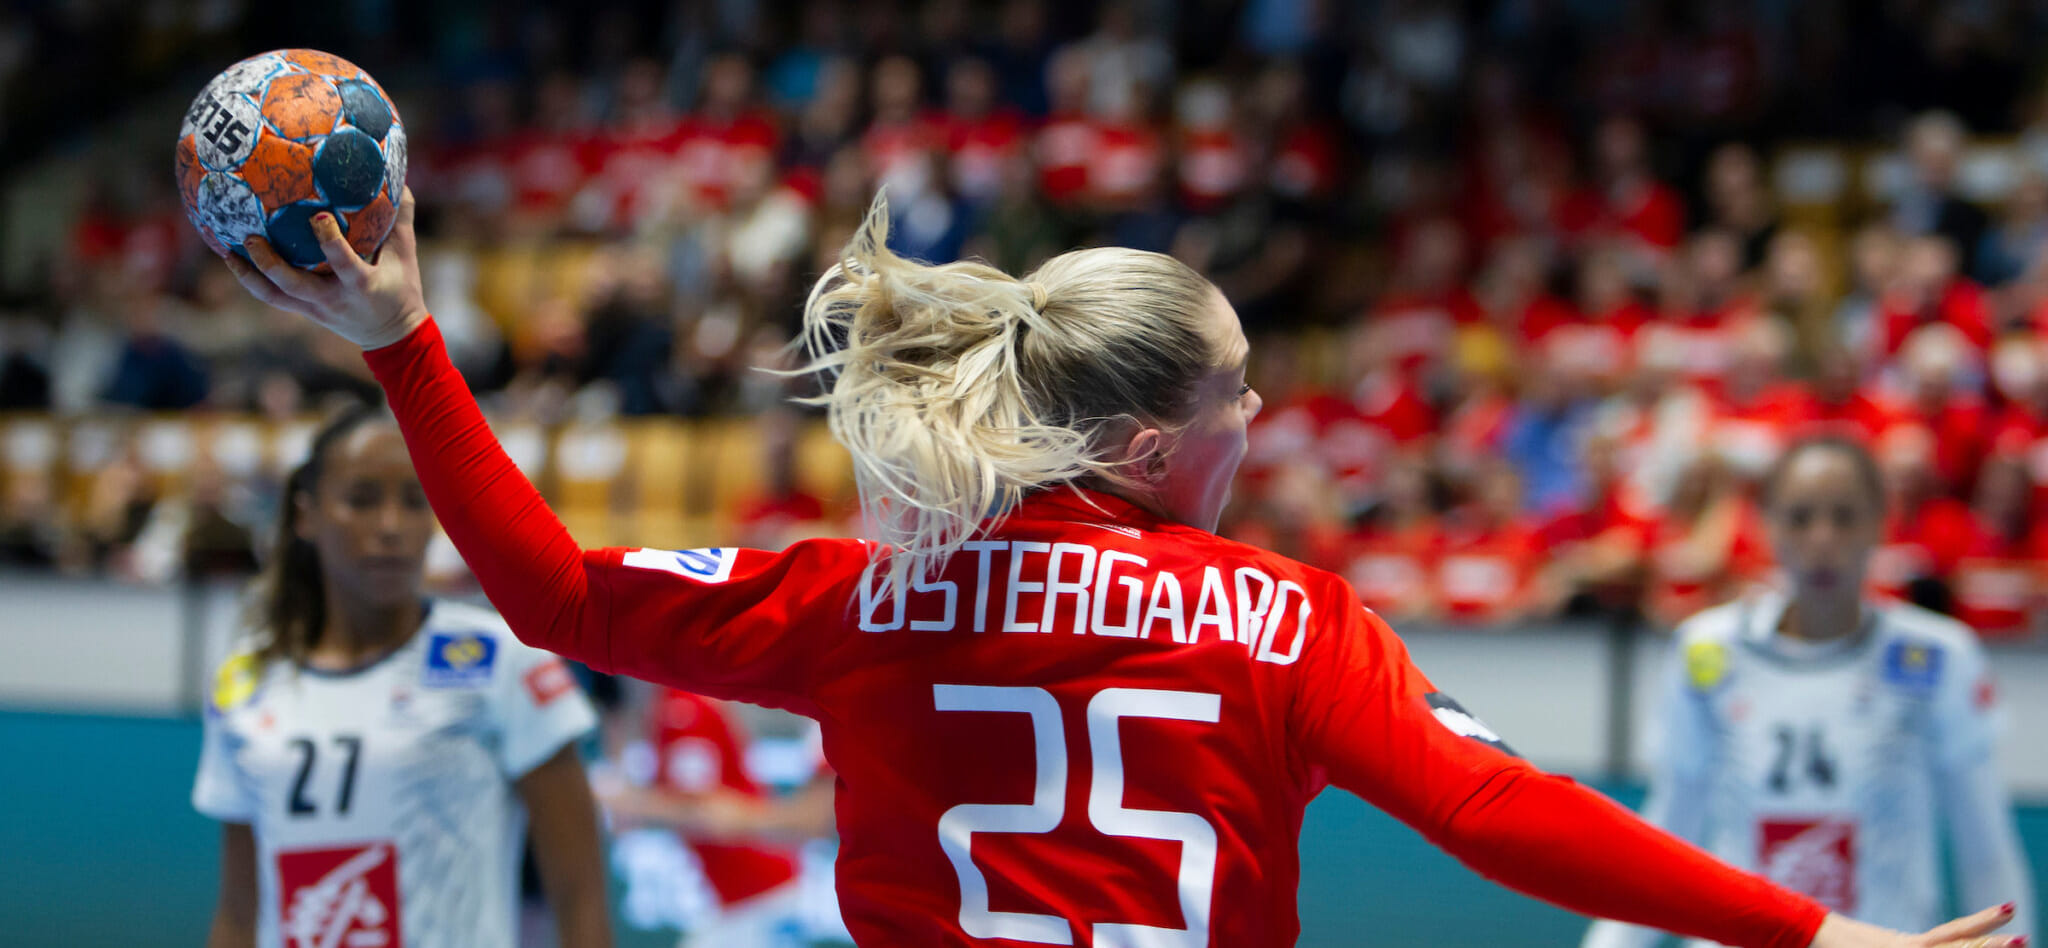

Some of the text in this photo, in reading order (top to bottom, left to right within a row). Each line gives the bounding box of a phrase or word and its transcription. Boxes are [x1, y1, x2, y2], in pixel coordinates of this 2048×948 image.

[858, 541, 1312, 665] ØSTERGAARD
[286, 736, 362, 816] 27
[933, 684, 1221, 948] 25
